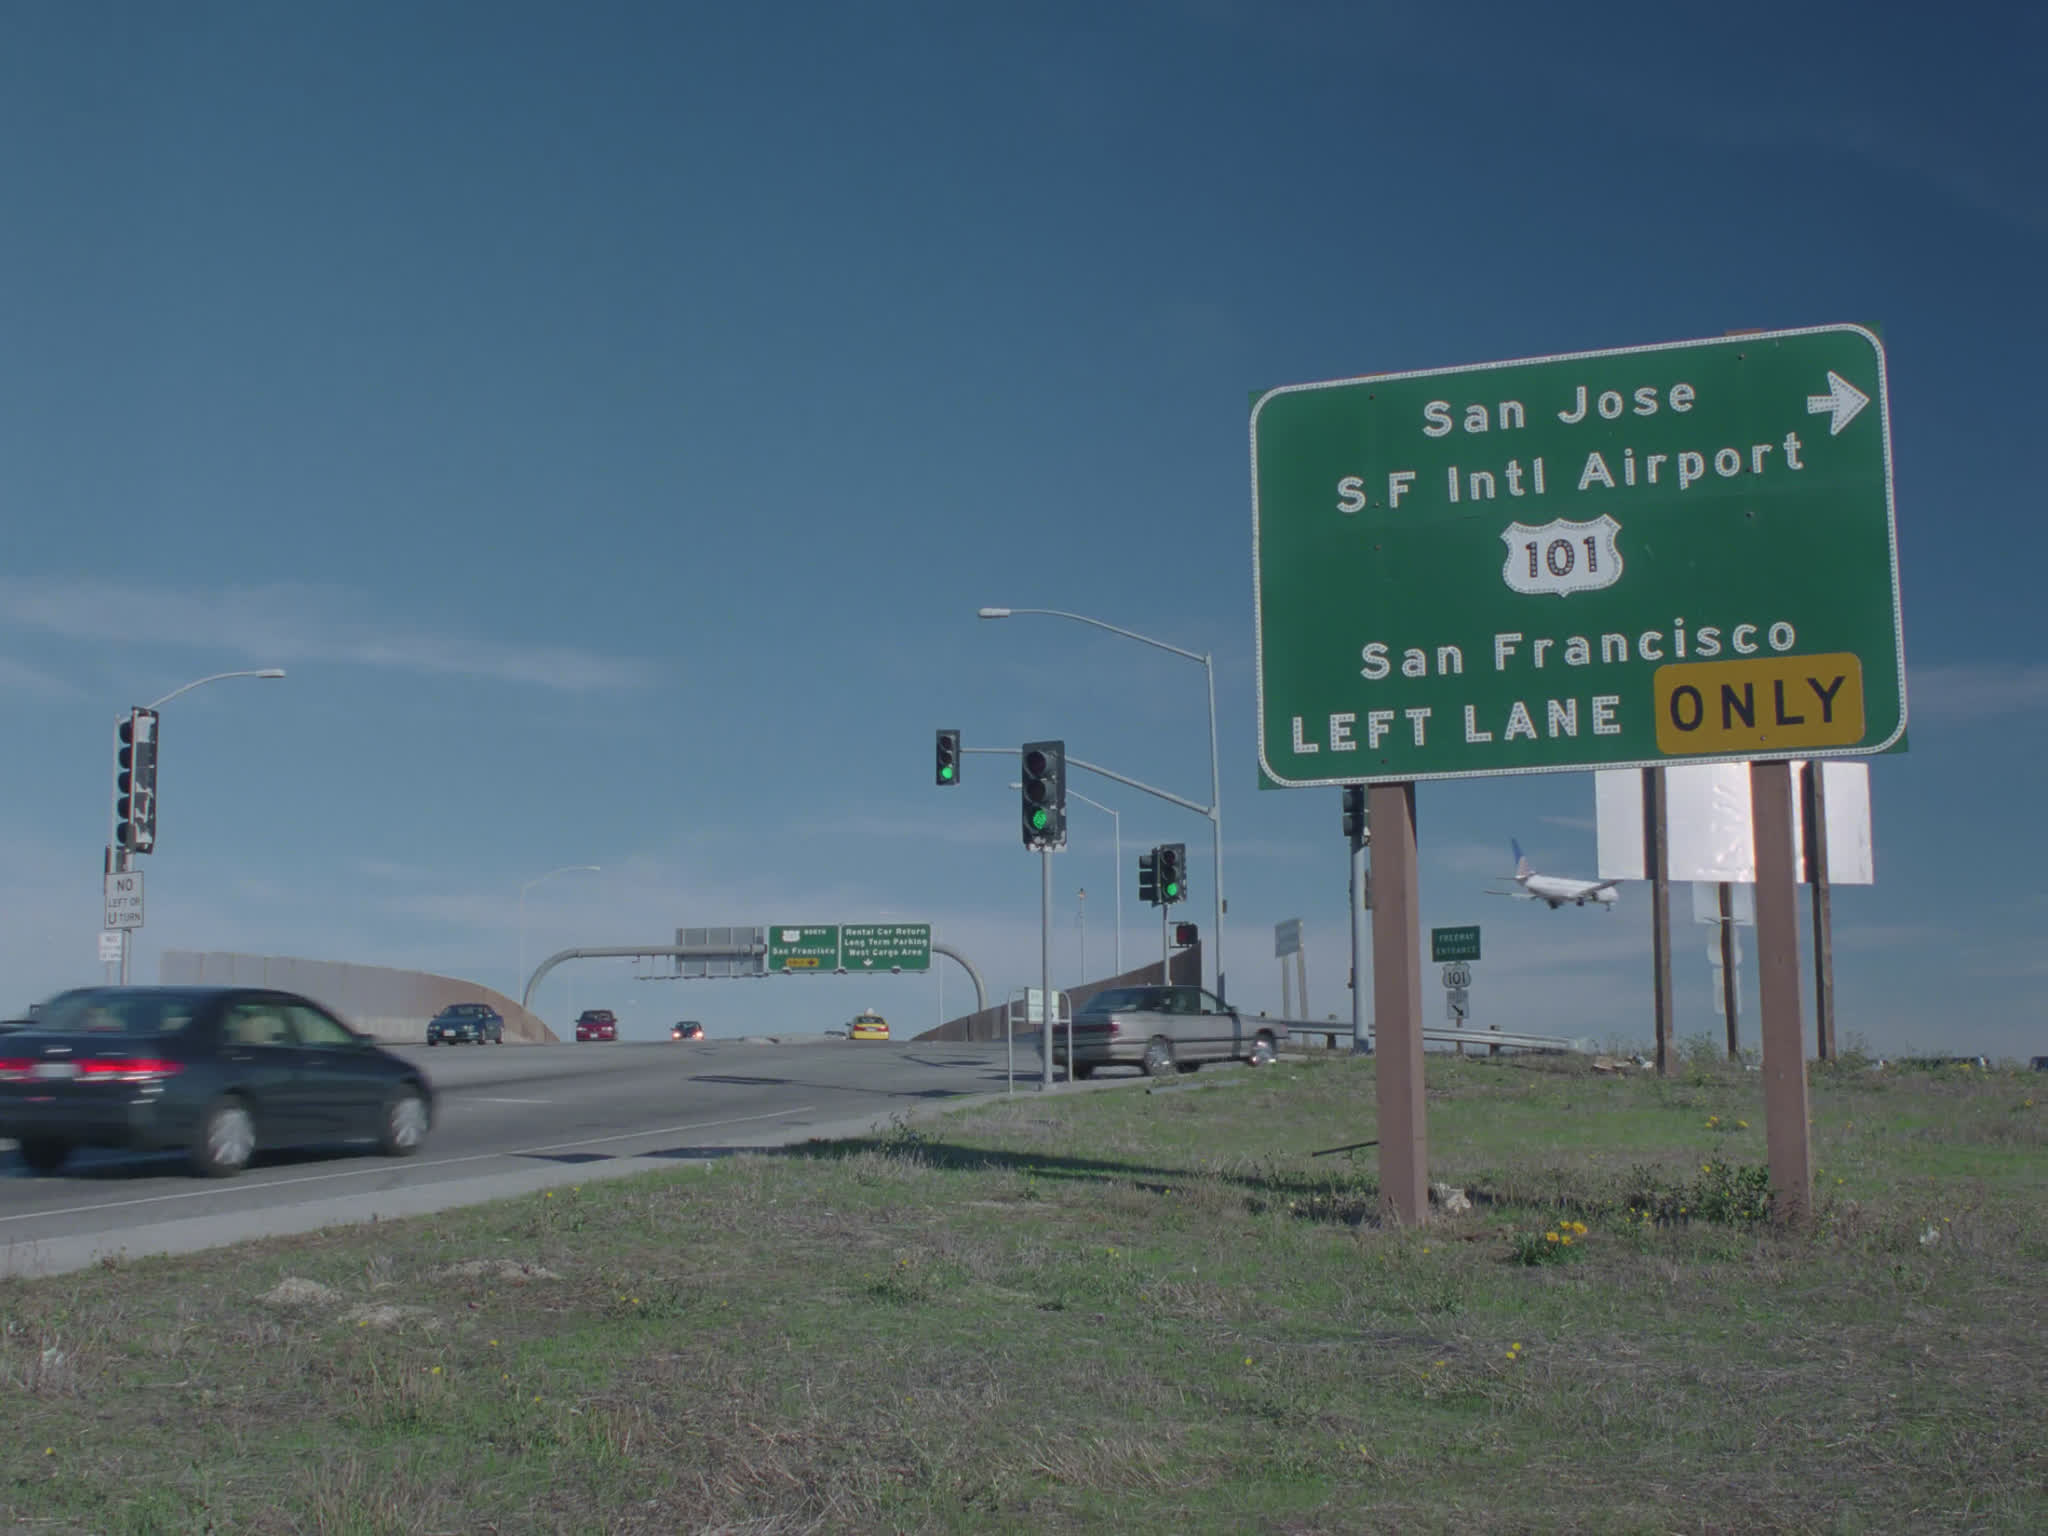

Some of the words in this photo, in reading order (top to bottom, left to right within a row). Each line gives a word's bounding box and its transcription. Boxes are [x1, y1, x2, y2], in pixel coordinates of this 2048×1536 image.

[1423, 399, 1526, 438] San
[1558, 382, 1696, 425] Jose
[1336, 475, 1366, 513] S
[1388, 471, 1417, 508] F
[1448, 457, 1545, 502] Intl
[1578, 432, 1804, 490] Airport
[1524, 535, 1597, 579] 101
[1360, 641, 1463, 680] San
[1494, 617, 1796, 670] Francisco
[1292, 707, 1432, 754] LEFT
[1464, 695, 1621, 743] LANE
[1669, 675, 1847, 733] ONLY
[117, 879, 133, 891] NO
[108, 911, 117, 925] U
[845, 927, 874, 936] Rental
[876, 927, 893, 936] Car
[895, 927, 927, 936] Return
[843, 938, 866, 948] Long
[868, 937, 891, 946] Term
[893, 937, 928, 948] Parking
[848, 948, 870, 957] West
[871, 948, 899, 958] Cargo
[901, 947, 923, 956] Area
[1448, 972, 1466, 985] 101
